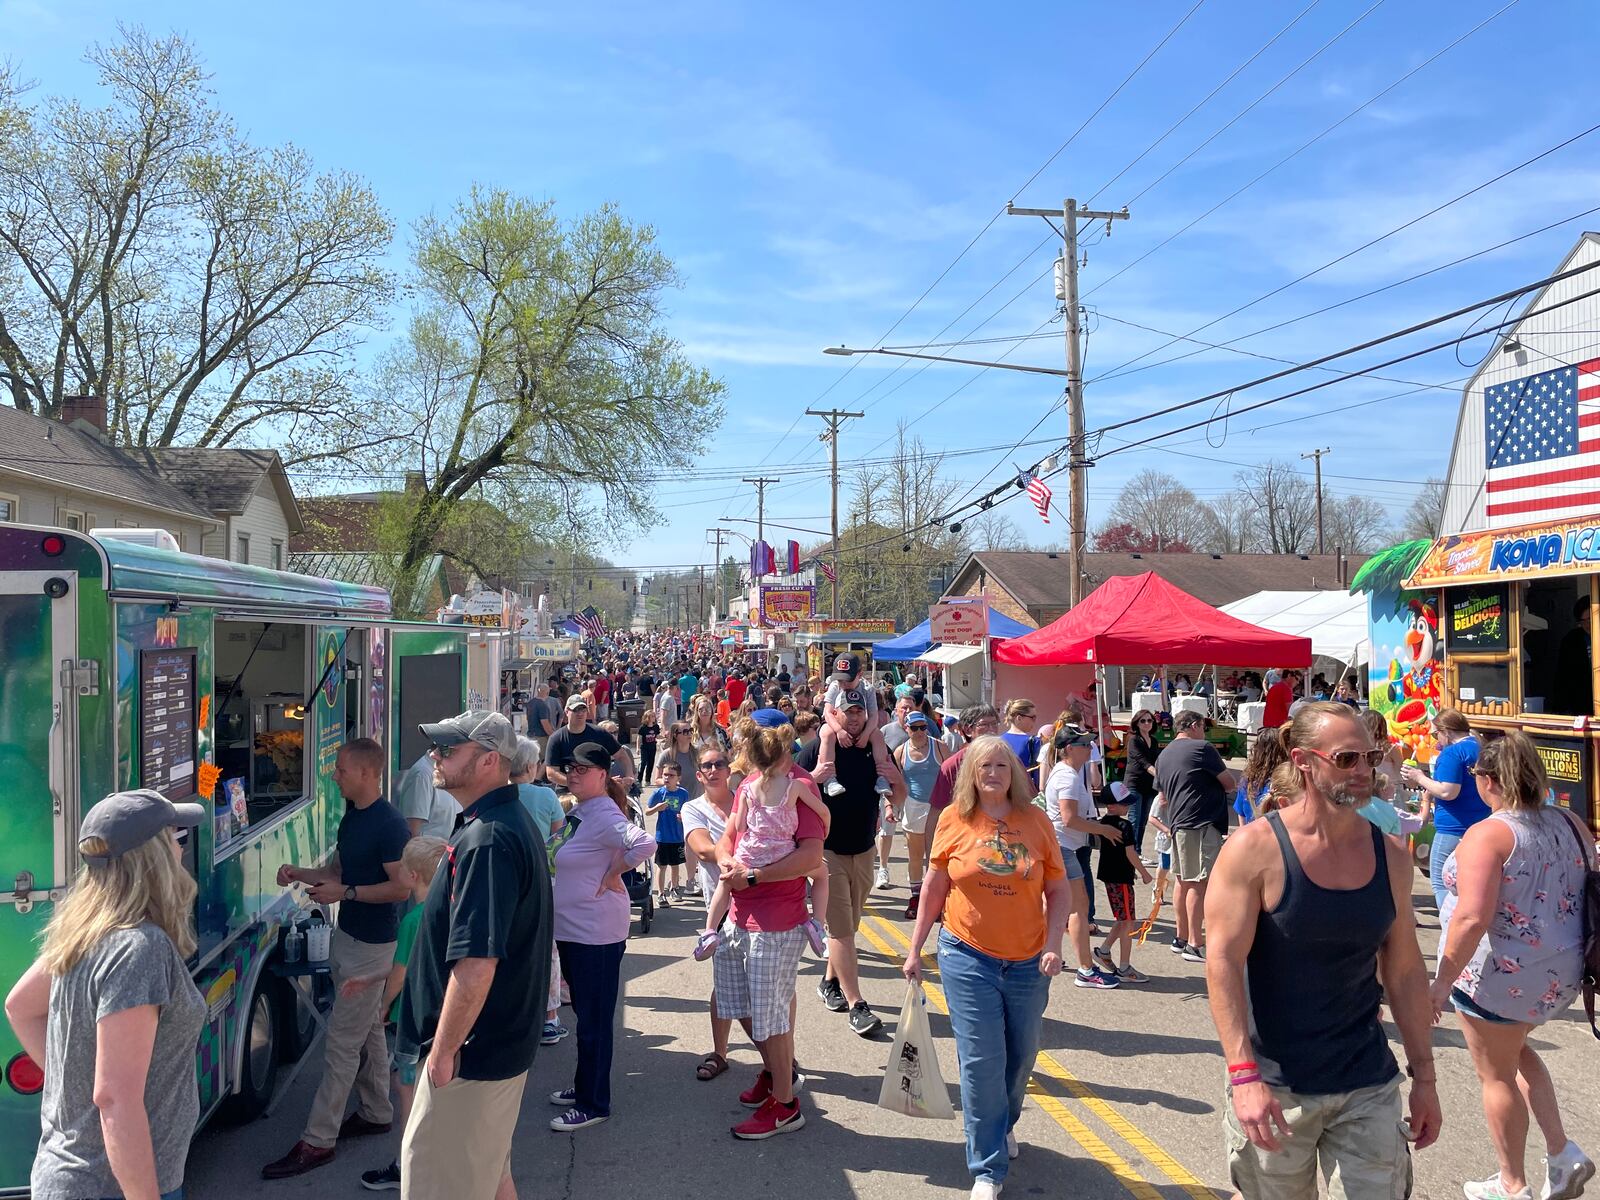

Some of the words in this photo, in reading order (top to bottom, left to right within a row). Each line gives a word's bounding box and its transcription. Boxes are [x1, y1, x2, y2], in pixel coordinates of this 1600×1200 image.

[1448, 545, 1482, 566] Tropical
[1489, 534, 1563, 571] KONA
[1563, 527, 1600, 564] ICE
[1453, 556, 1484, 575] Shaved
[1454, 605, 1502, 631] DELICIOUS
[1571, 753, 1578, 763] &
